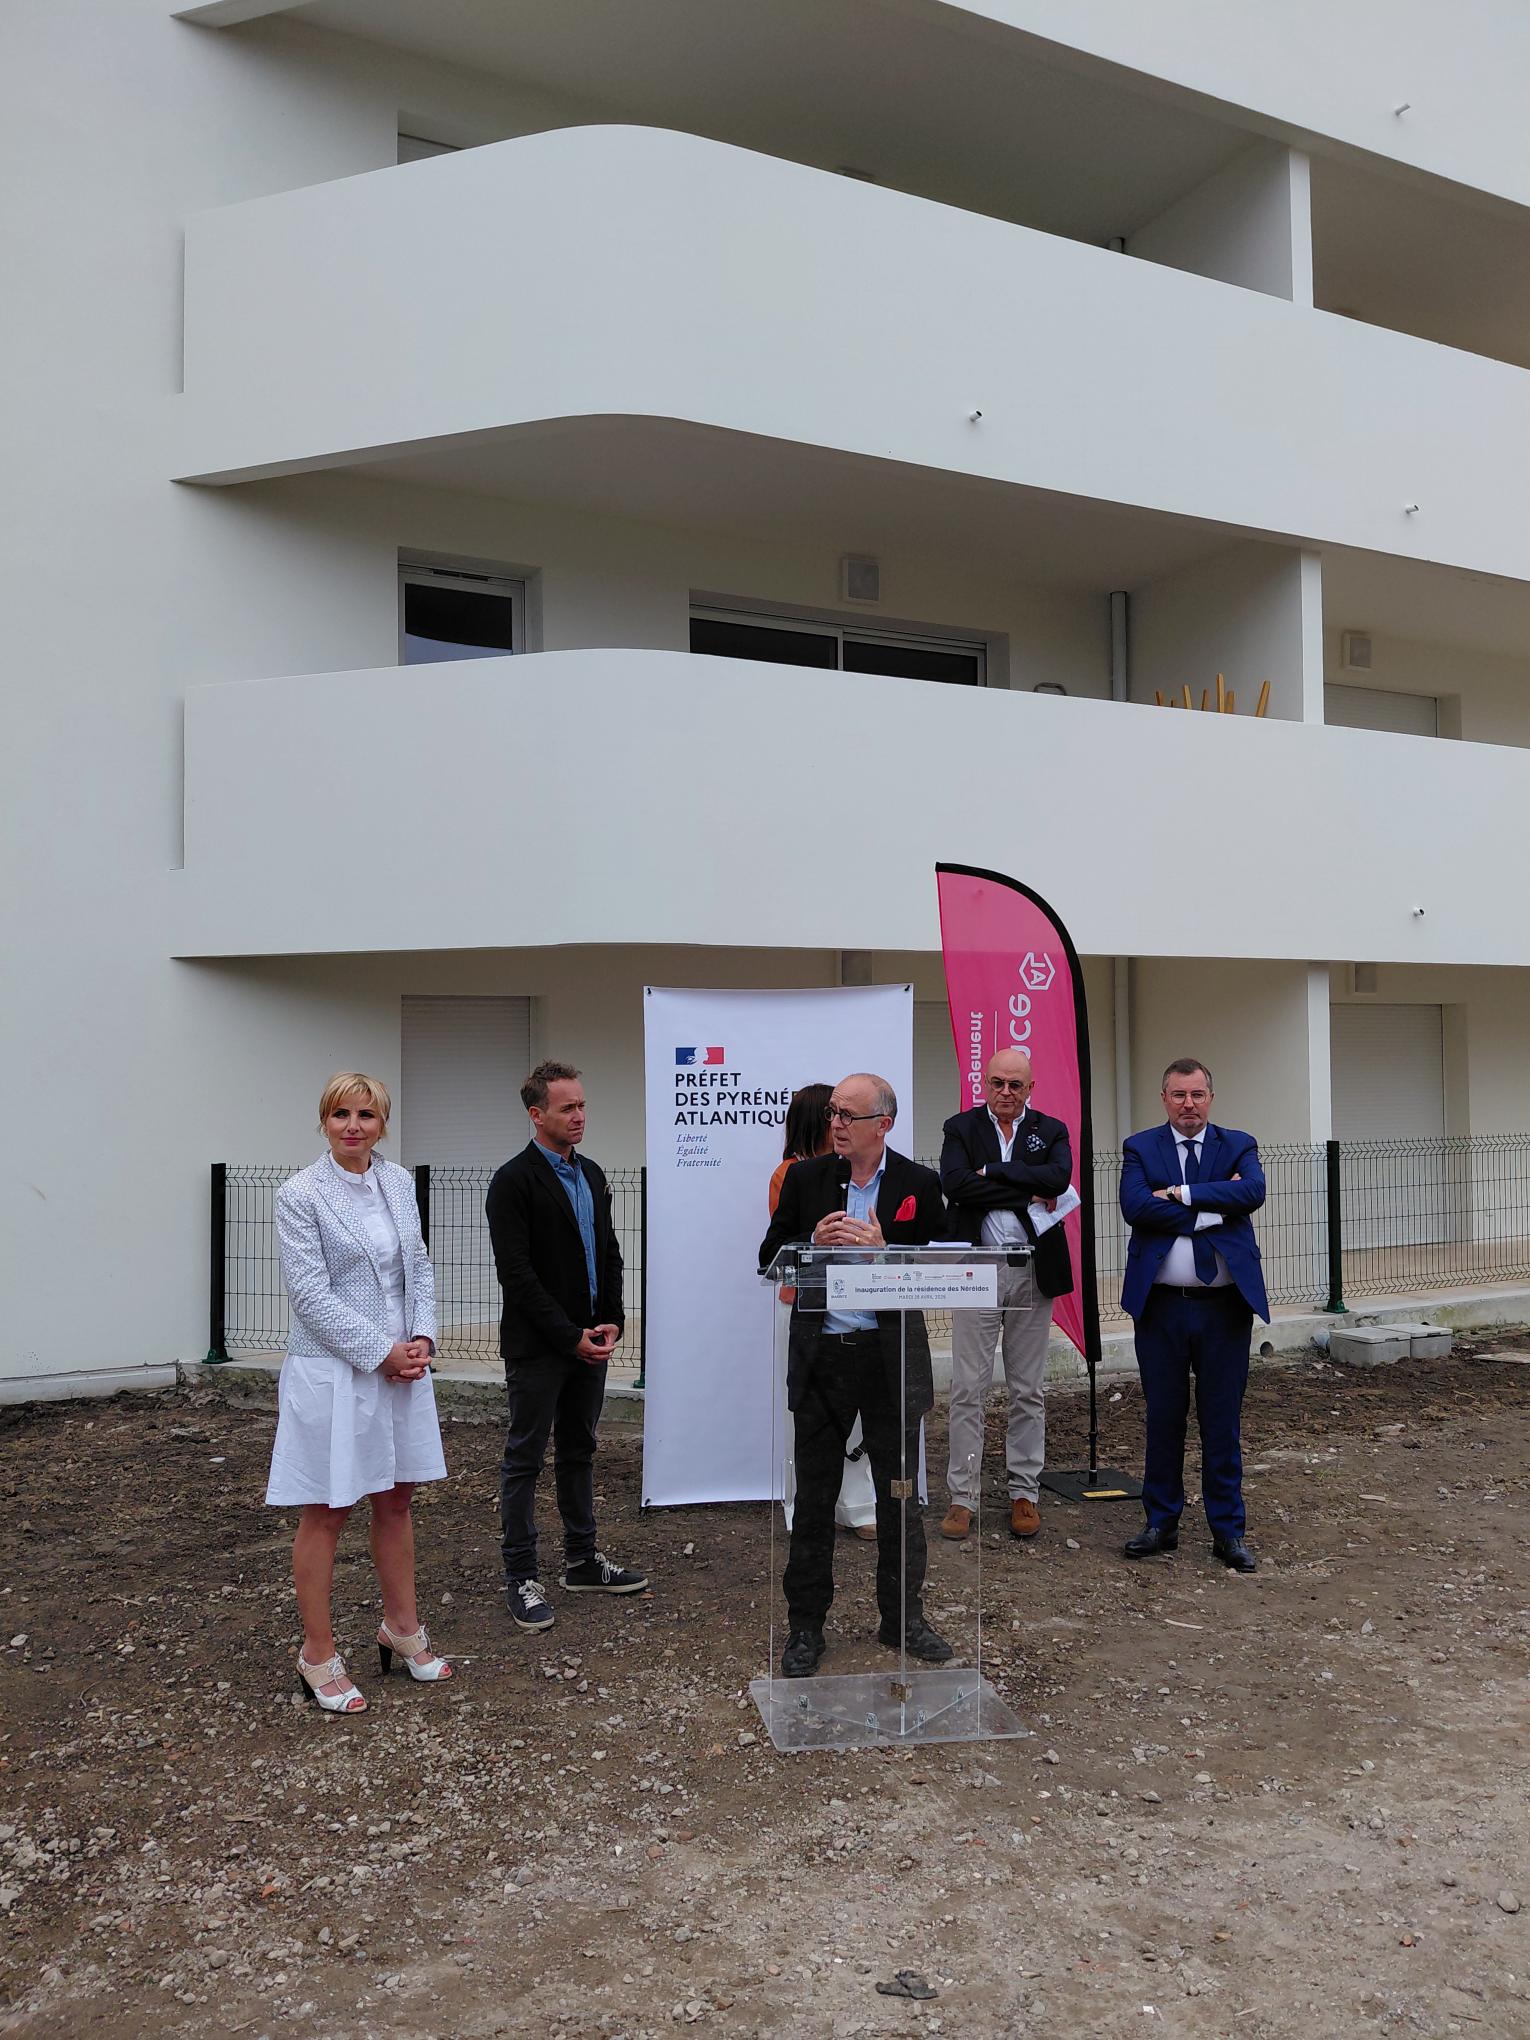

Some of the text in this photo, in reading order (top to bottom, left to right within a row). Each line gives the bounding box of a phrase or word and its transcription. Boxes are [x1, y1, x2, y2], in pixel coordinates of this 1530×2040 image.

[675, 1069, 742, 1087] PRÉFET
[675, 1091, 710, 1106] DES
[674, 1110, 786, 1127] ATLANTIQU
[676, 1134, 708, 1143] Liberté
[676, 1145, 709, 1157] Égalité
[676, 1158, 722, 1167] Fraternité
[854, 1285, 897, 1294] Inauguration
